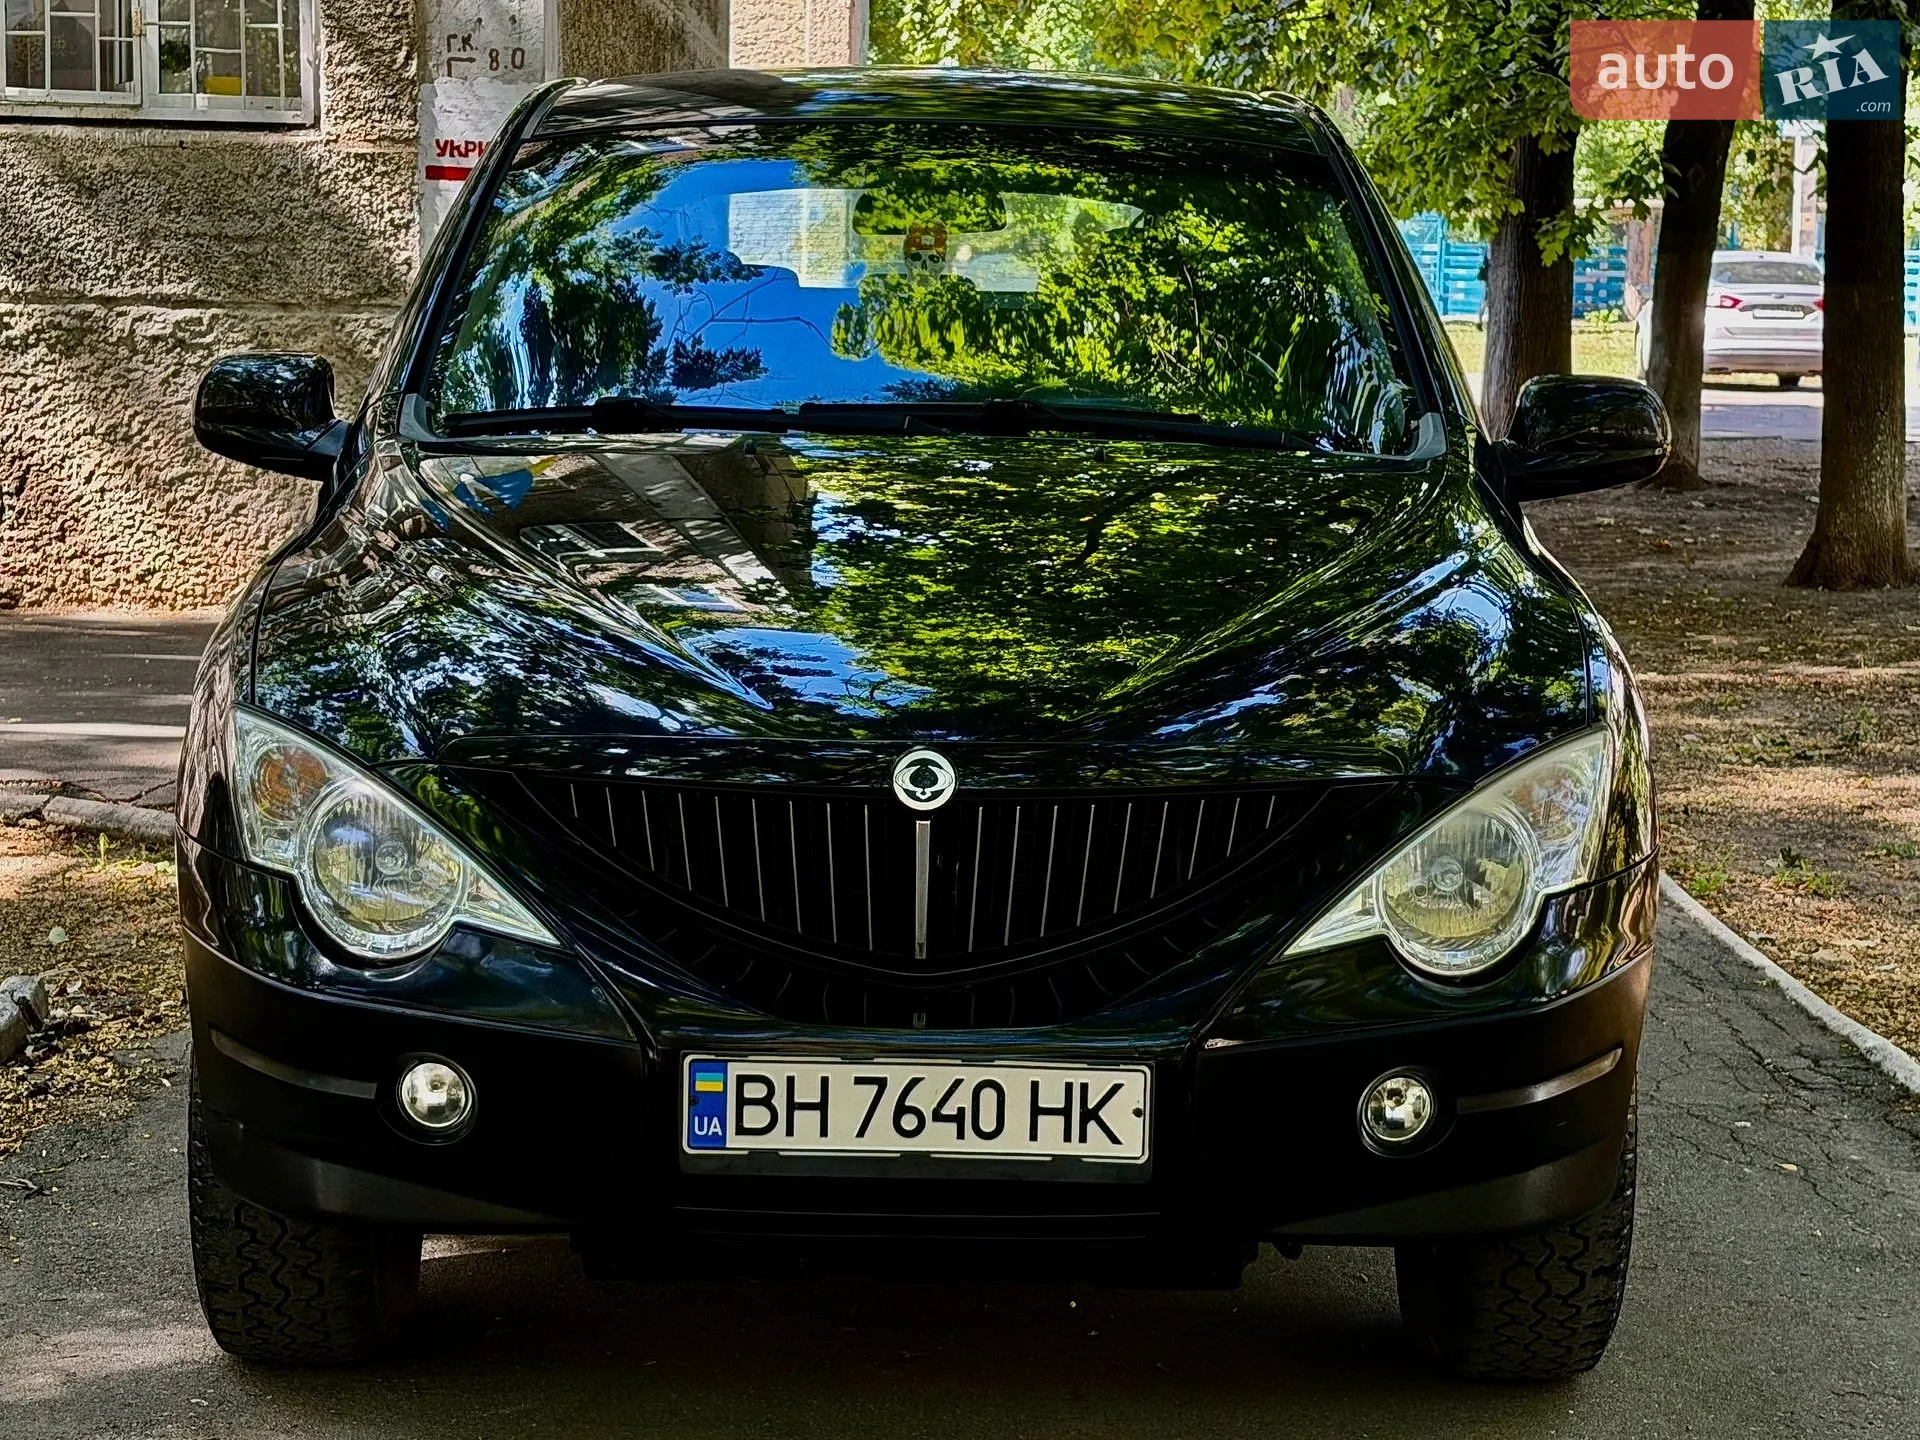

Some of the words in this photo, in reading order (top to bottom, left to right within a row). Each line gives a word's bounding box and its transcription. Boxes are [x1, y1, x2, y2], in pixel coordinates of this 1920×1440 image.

[694, 1115, 722, 1137] UA
[735, 1074, 830, 1138] BH
[853, 1076, 1006, 1141] 7640
[1029, 1079, 1125, 1146] HK
